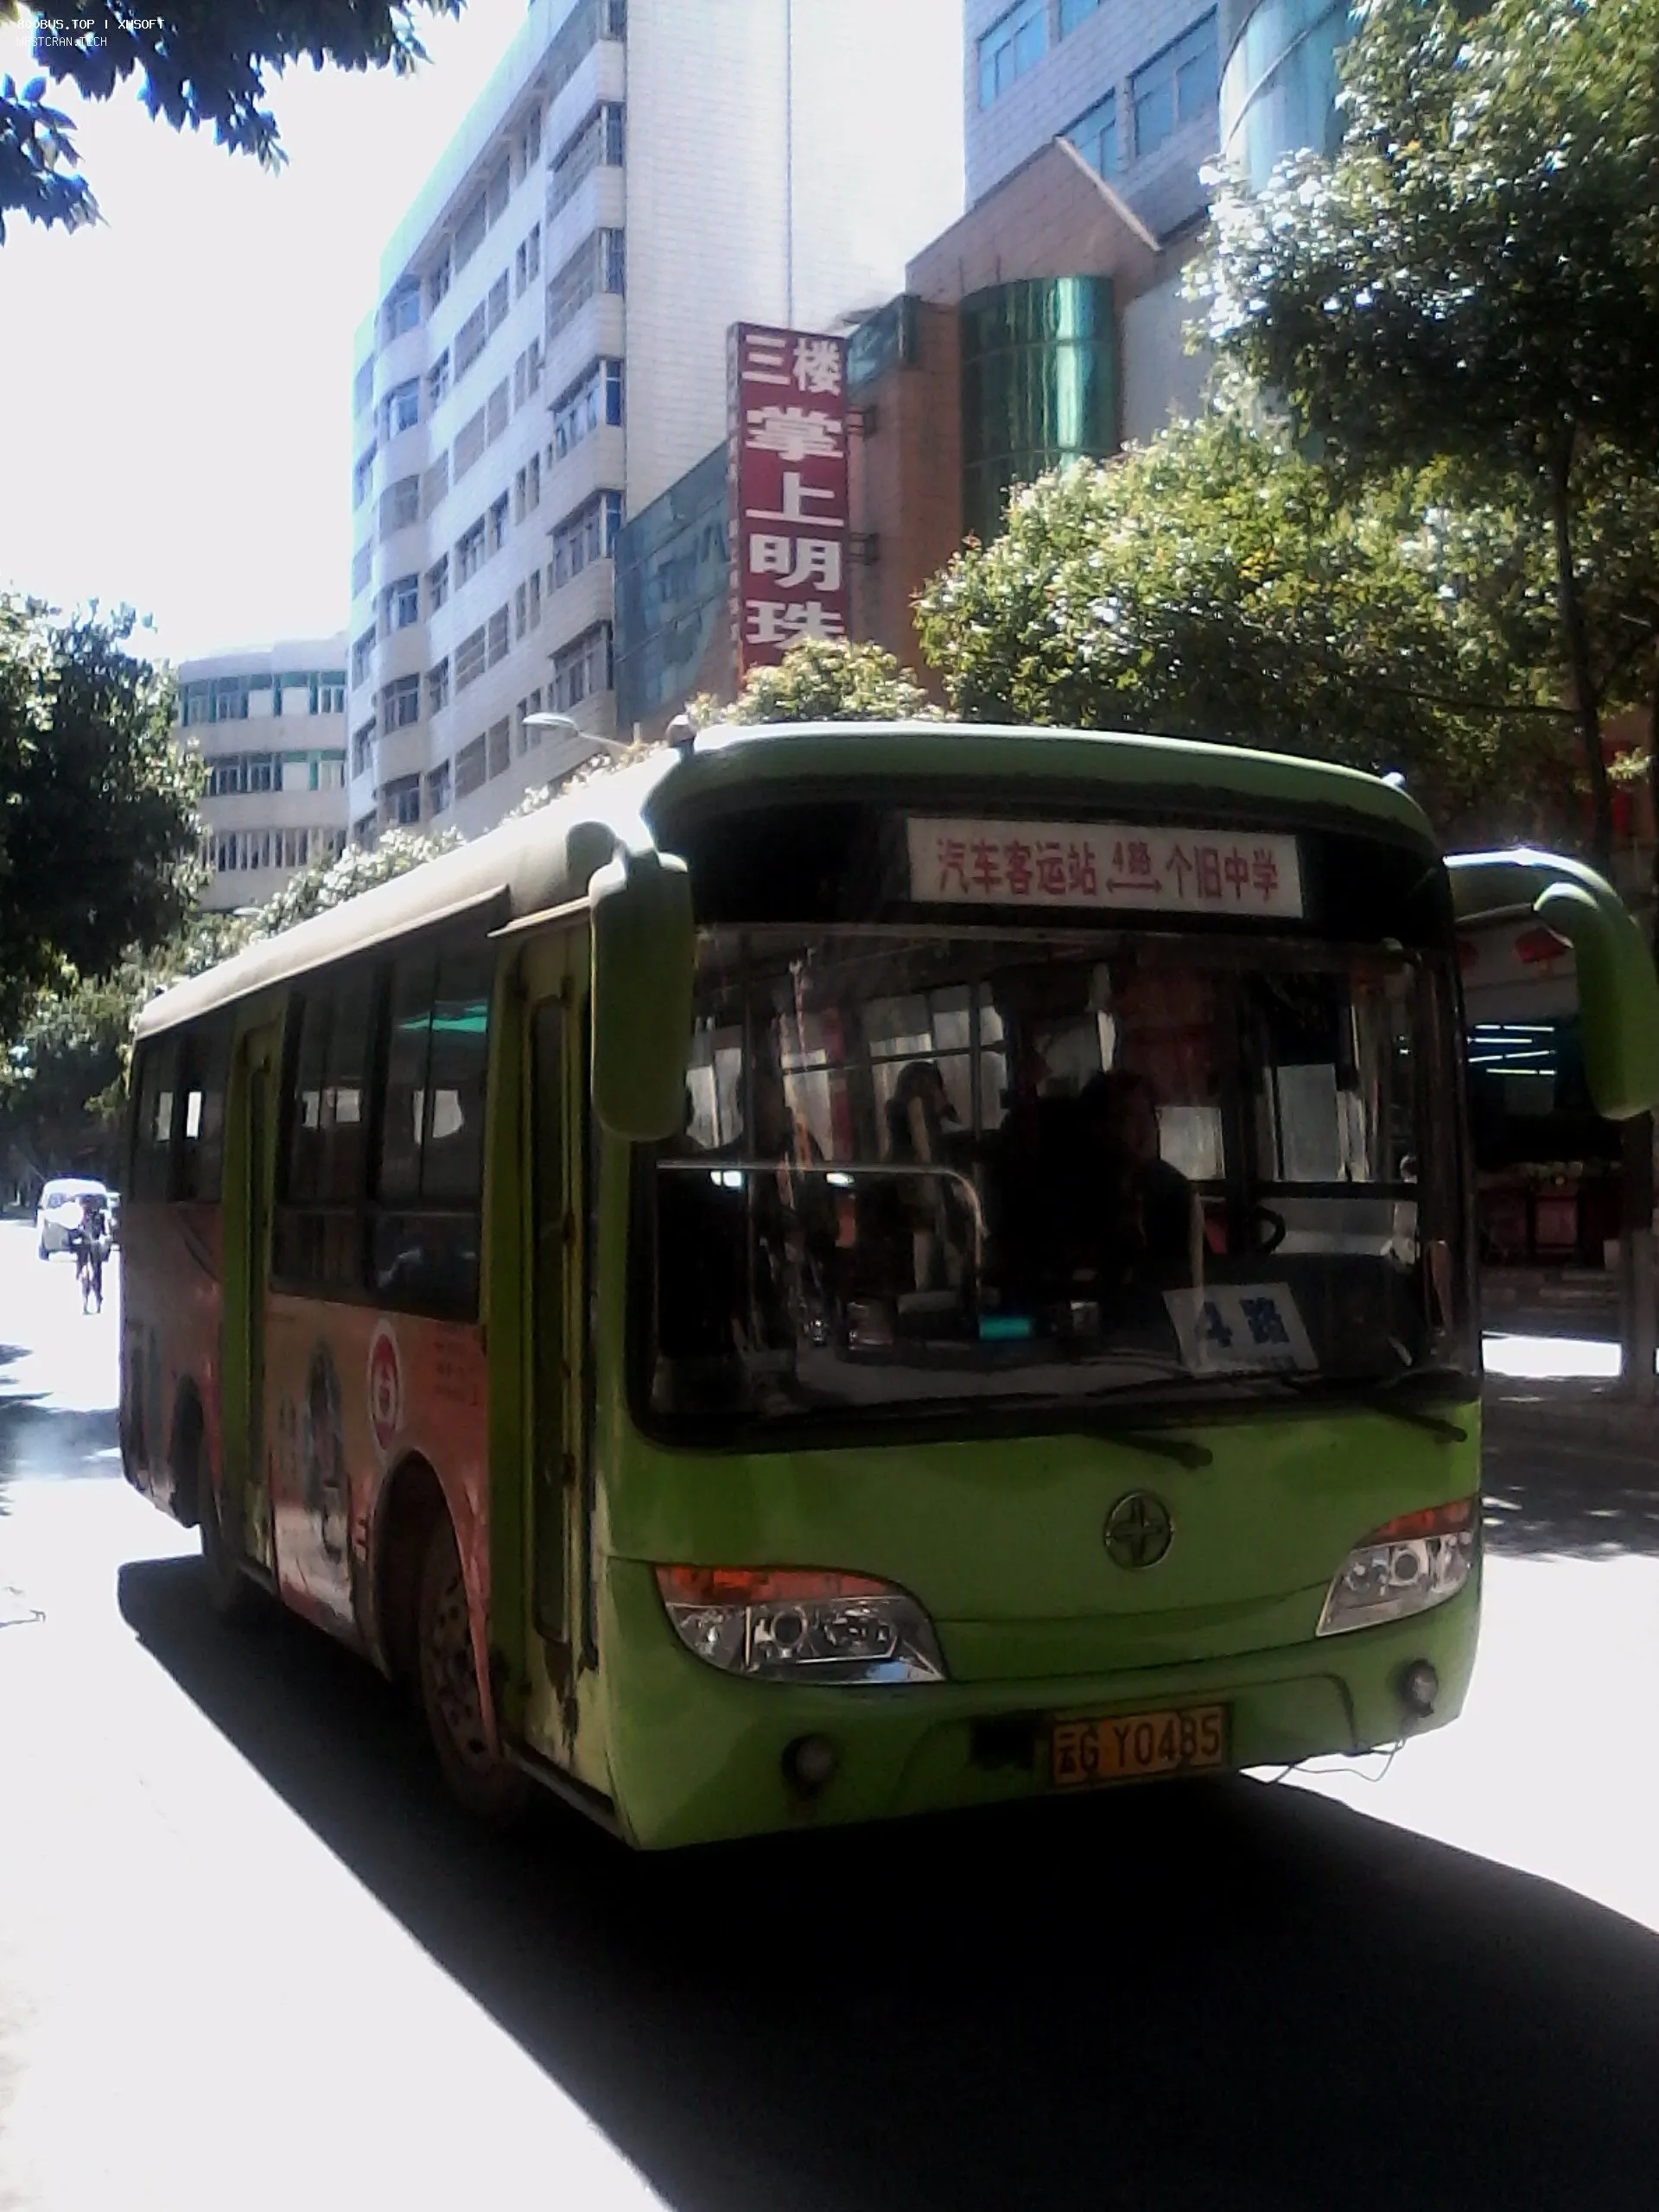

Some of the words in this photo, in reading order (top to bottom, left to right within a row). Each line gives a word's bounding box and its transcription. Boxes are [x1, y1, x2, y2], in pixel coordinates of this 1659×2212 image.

[741, 334, 842, 397] 三楼
[745, 405, 845, 651] 掌上明珠
[937, 836, 1097, 896] 汽车客运站
[1165, 844, 1280, 902] 个旧中学
